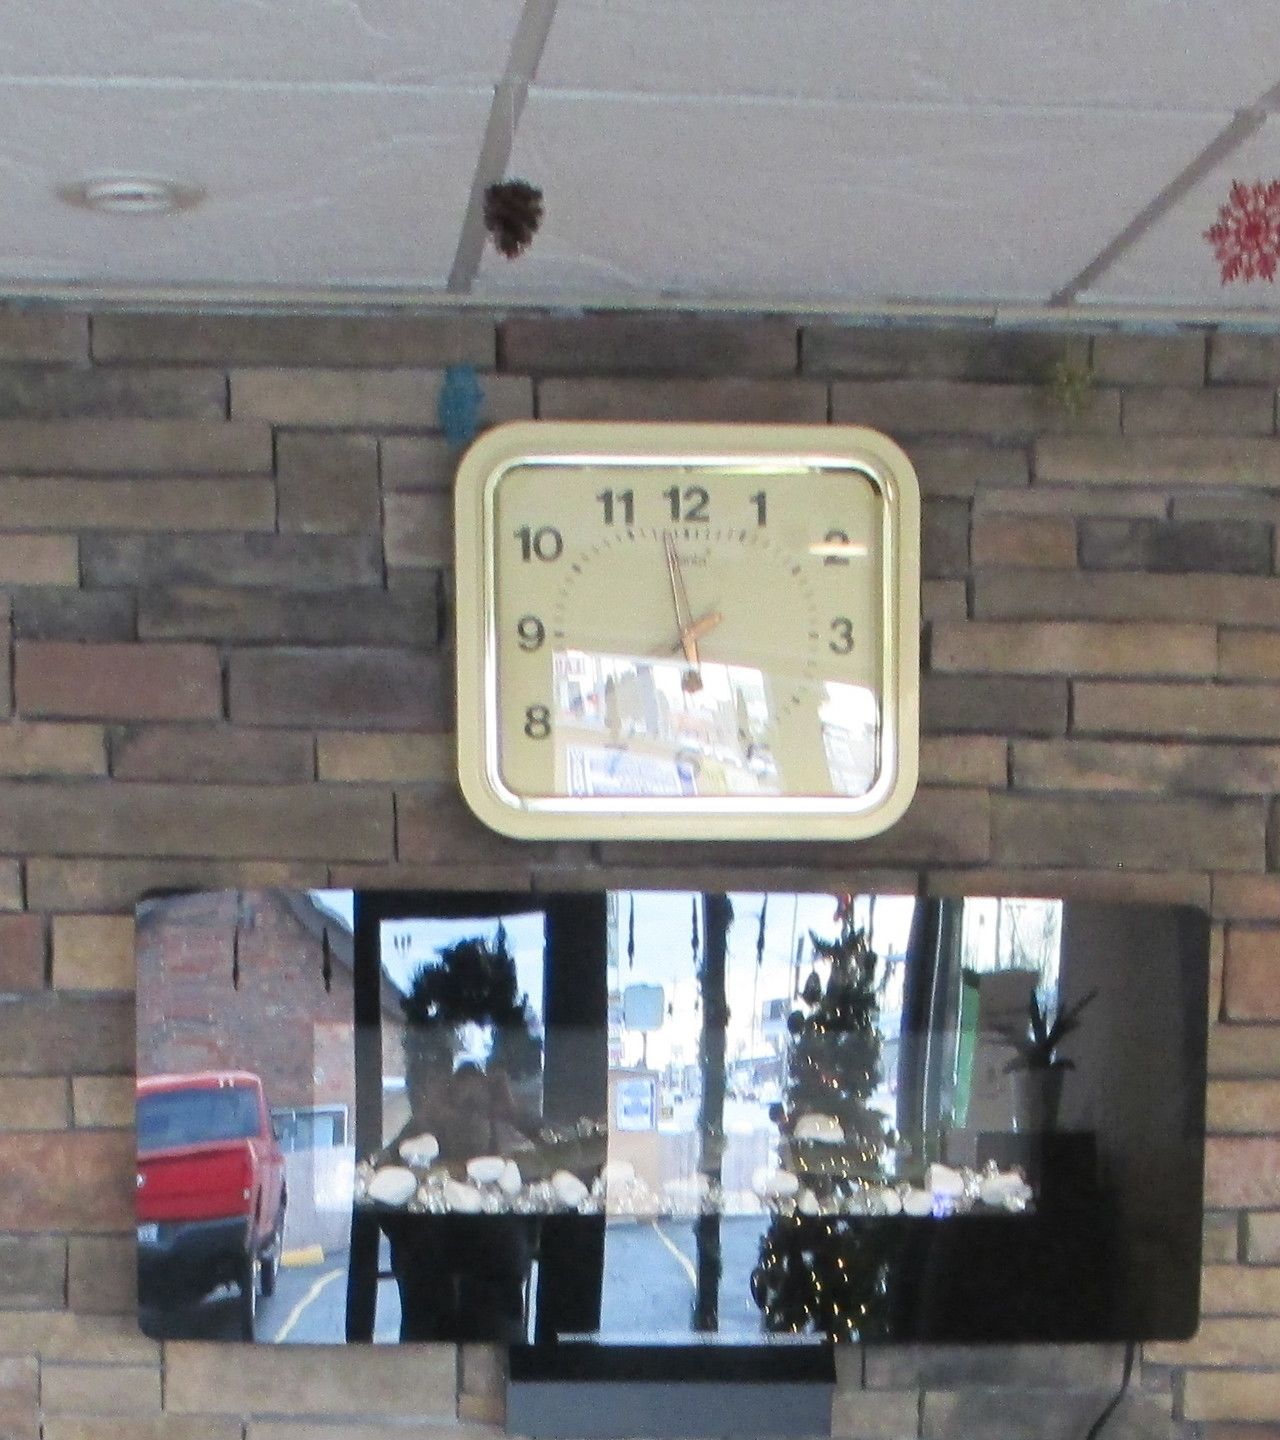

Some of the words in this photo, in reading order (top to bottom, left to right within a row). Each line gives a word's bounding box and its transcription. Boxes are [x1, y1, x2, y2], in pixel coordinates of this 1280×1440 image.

[596, 487, 634, 525] 11
[662, 485, 710, 523] 12
[749, 490, 767, 527] 1
[513, 525, 564, 562] 10
[823, 528, 850, 567] 2
[517, 614, 545, 653] 9
[828, 616, 855, 655] 3
[524, 703, 552, 740] 8
